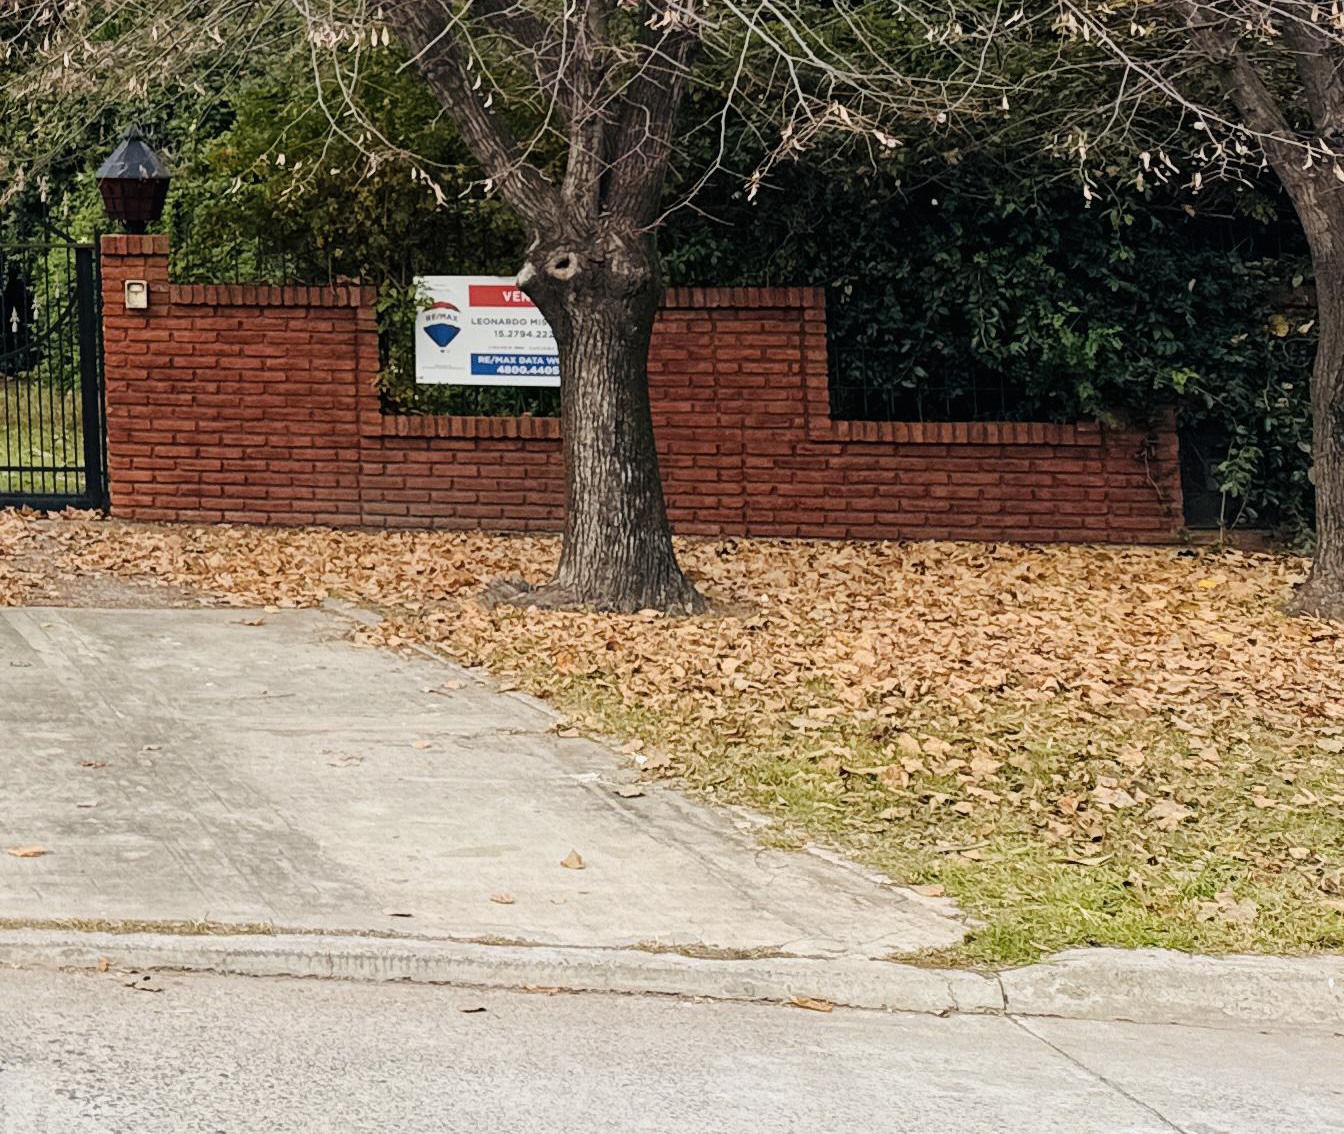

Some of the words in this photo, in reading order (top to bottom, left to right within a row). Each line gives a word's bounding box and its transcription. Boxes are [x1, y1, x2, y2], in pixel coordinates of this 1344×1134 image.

[502, 290, 531, 303] VEN
[425, 313, 457, 322] RE/MAX
[471, 318, 527, 326] LEONARDO
[494, 330, 554, 338] 15.2794.222
[477, 355, 517, 364] RE/MAX
[518, 356, 544, 364] DATA
